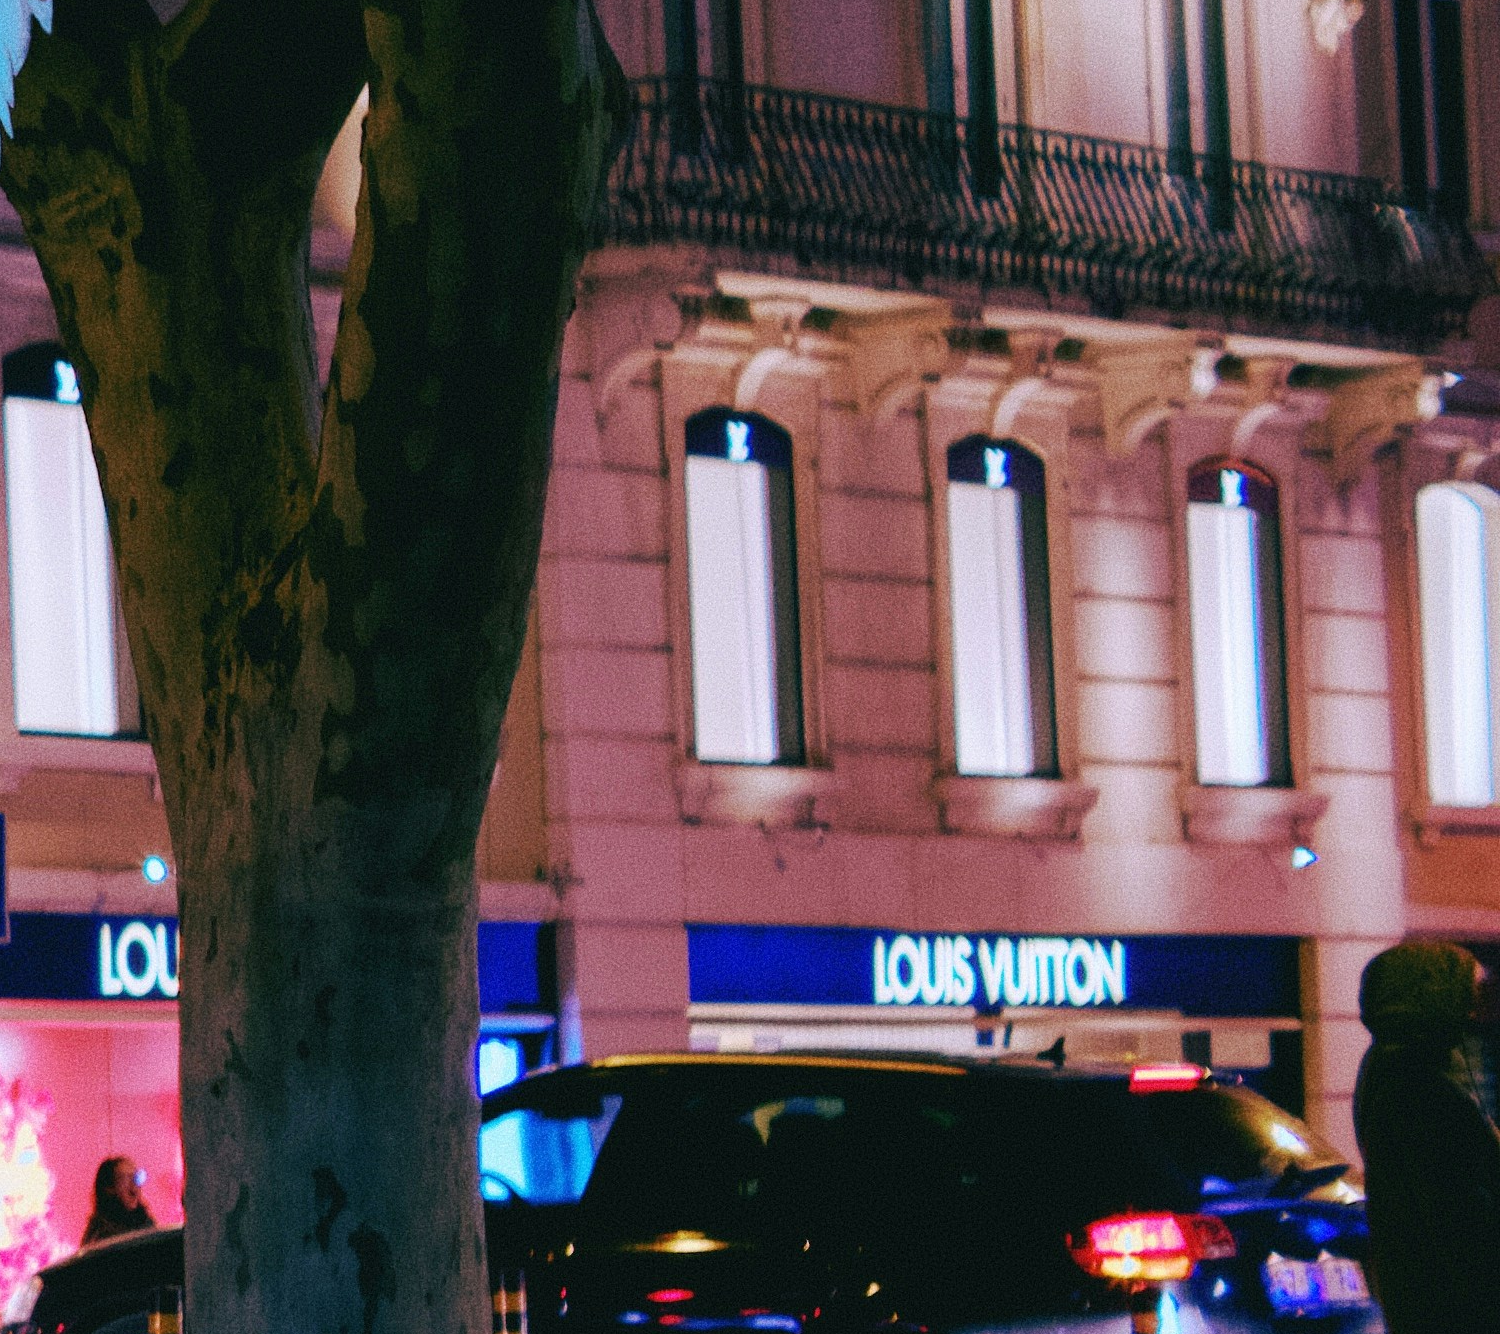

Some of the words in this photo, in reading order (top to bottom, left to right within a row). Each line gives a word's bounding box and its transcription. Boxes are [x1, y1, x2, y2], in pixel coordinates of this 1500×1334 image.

[100, 921, 180, 997] LOU
[873, 934, 977, 1006] LOUIS
[977, 936, 1127, 1007] VUITTON
